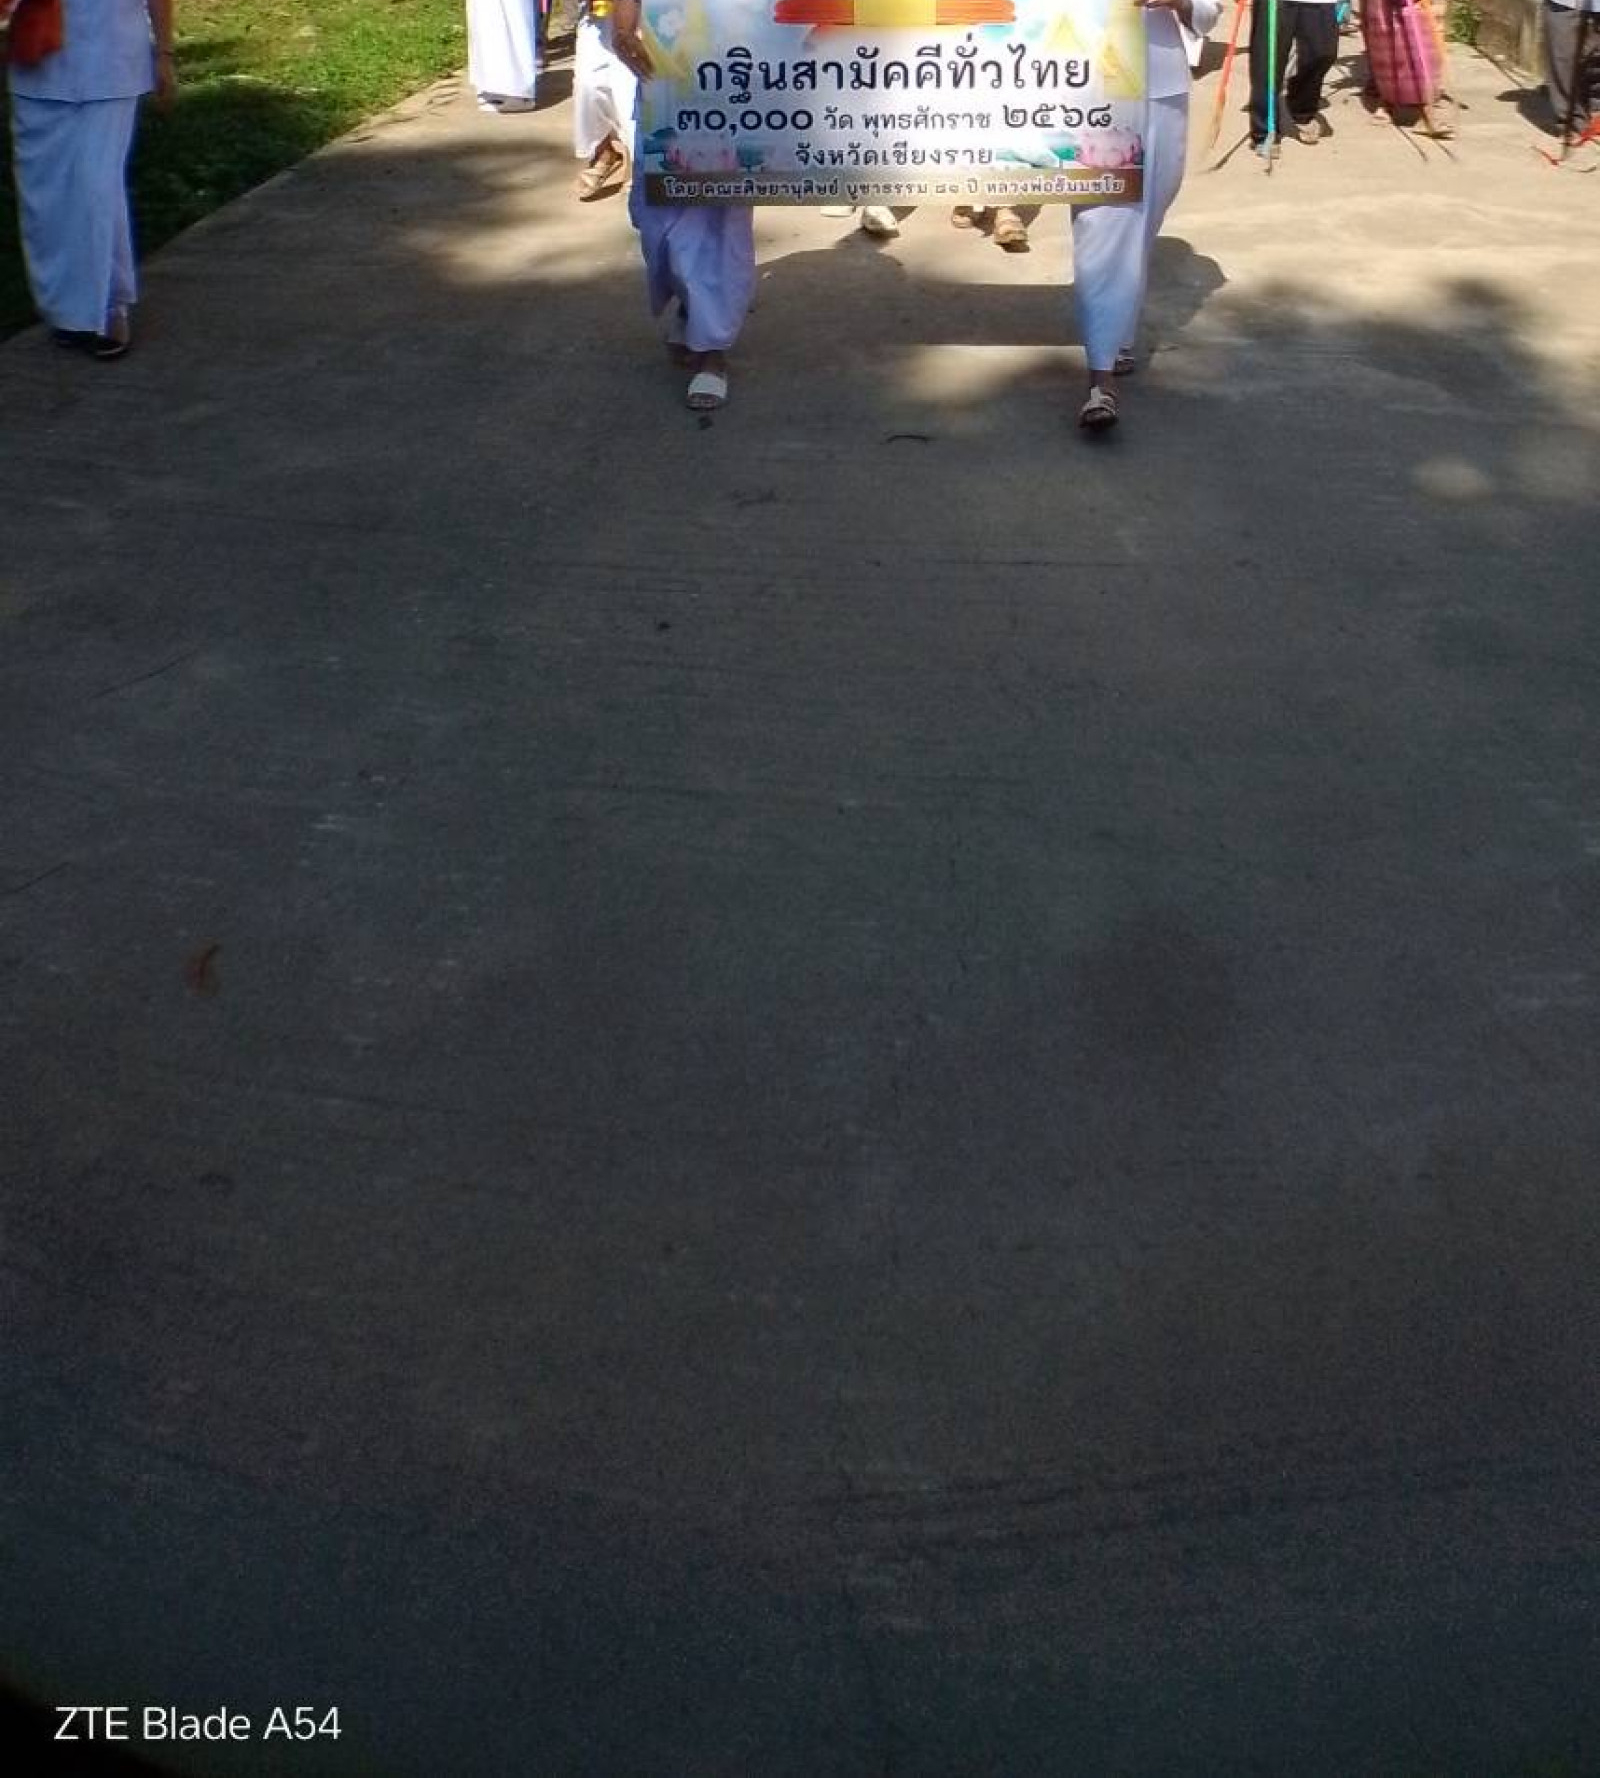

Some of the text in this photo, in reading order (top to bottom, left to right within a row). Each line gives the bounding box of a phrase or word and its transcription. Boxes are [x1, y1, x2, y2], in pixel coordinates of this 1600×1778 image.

[697, 33, 1090, 104] กฐินสามัคคีทั่วไทย
[677, 103, 1112, 138] ๓๐,๐๐๐ วัด พุทธศักราช ๒๕๖๘
[794, 141, 993, 166] จังหวัดเชียงราย
[664, 176, 697, 198] โดย
[703, 177, 839, 199] คณะศิษยานุศิษย์
[846, 180, 928, 201] บูชาธรรม
[967, 177, 978, 195] ปี
